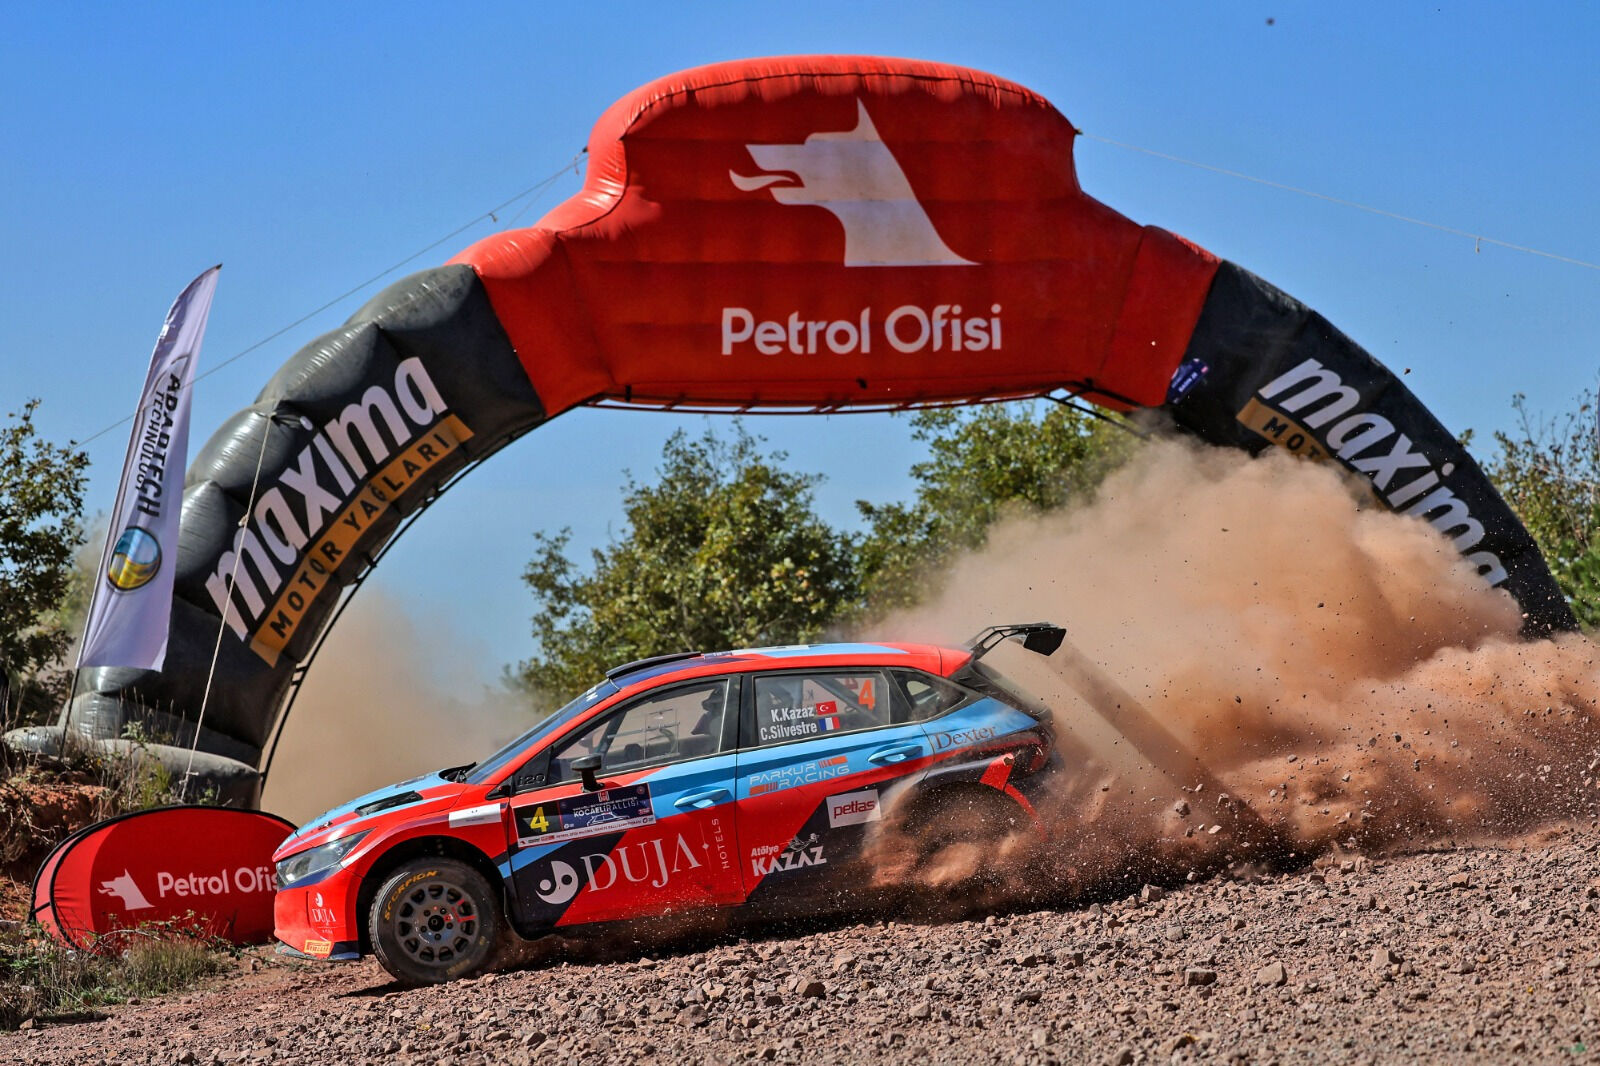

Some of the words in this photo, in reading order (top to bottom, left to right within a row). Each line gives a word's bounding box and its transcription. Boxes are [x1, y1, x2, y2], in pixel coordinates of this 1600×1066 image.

[721, 307, 871, 355] Petrol
[884, 304, 1002, 353] Ofisi
[1258, 358, 1509, 588] maxima
[205, 356, 448, 642] maxima
[269, 540, 343, 639] MOTOR
[343, 433, 450, 532] YAĞLARI
[858, 679, 876, 710] 4
[771, 706, 815, 722] K.Kazaz
[760, 721, 818, 741] C.Silvestre
[934, 726, 996, 750] Dexter
[750, 762, 816, 785] PARKUR
[778, 765, 850, 788] RACING
[530, 806, 549, 832] 4
[833, 800, 876, 819] petlas
[711, 818, 730, 870] HOTELS
[751, 845, 779, 857] Atölye
[580, 833, 703, 892] DUJA
[751, 845, 828, 877] KAZAZ
[157, 868, 230, 898] Petrol
